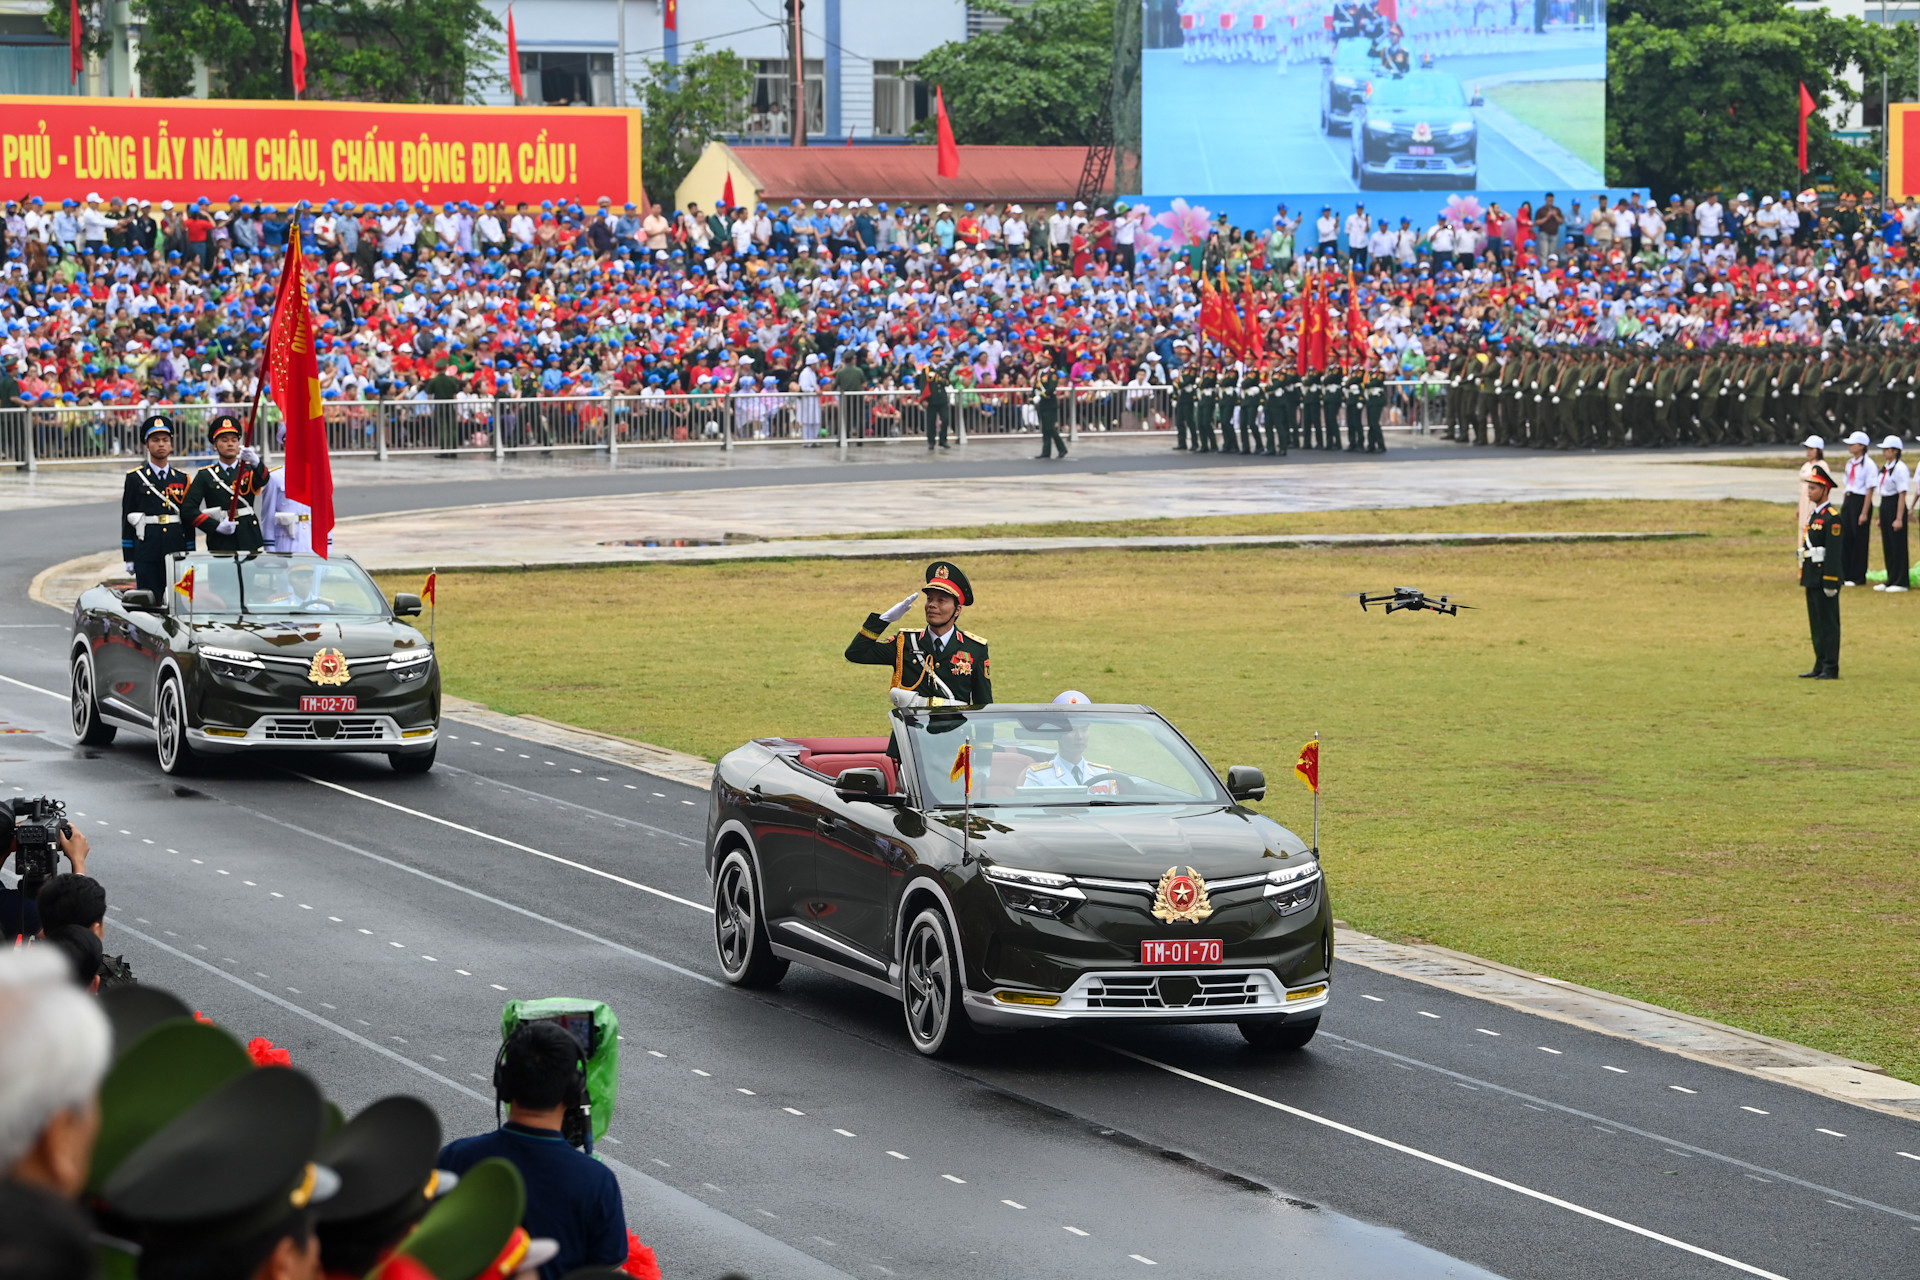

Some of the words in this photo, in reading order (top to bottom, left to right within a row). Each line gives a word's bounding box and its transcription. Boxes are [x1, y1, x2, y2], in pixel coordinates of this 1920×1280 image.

[3, 120, 51, 179] PHỦ
[74, 126, 137, 179] LỪNG
[143, 120, 186, 180] LẪY
[193, 129, 248, 180] NĂM
[255, 129, 326, 187] CHÂU,
[331, 125, 396, 182] CHẤN
[401, 132, 466, 193] ĐỘNG
[471, 142, 513, 194] ĐỊA
[302, 697, 355, 711] TM-02-70
[1144, 942, 1219, 962] TM-01-70
